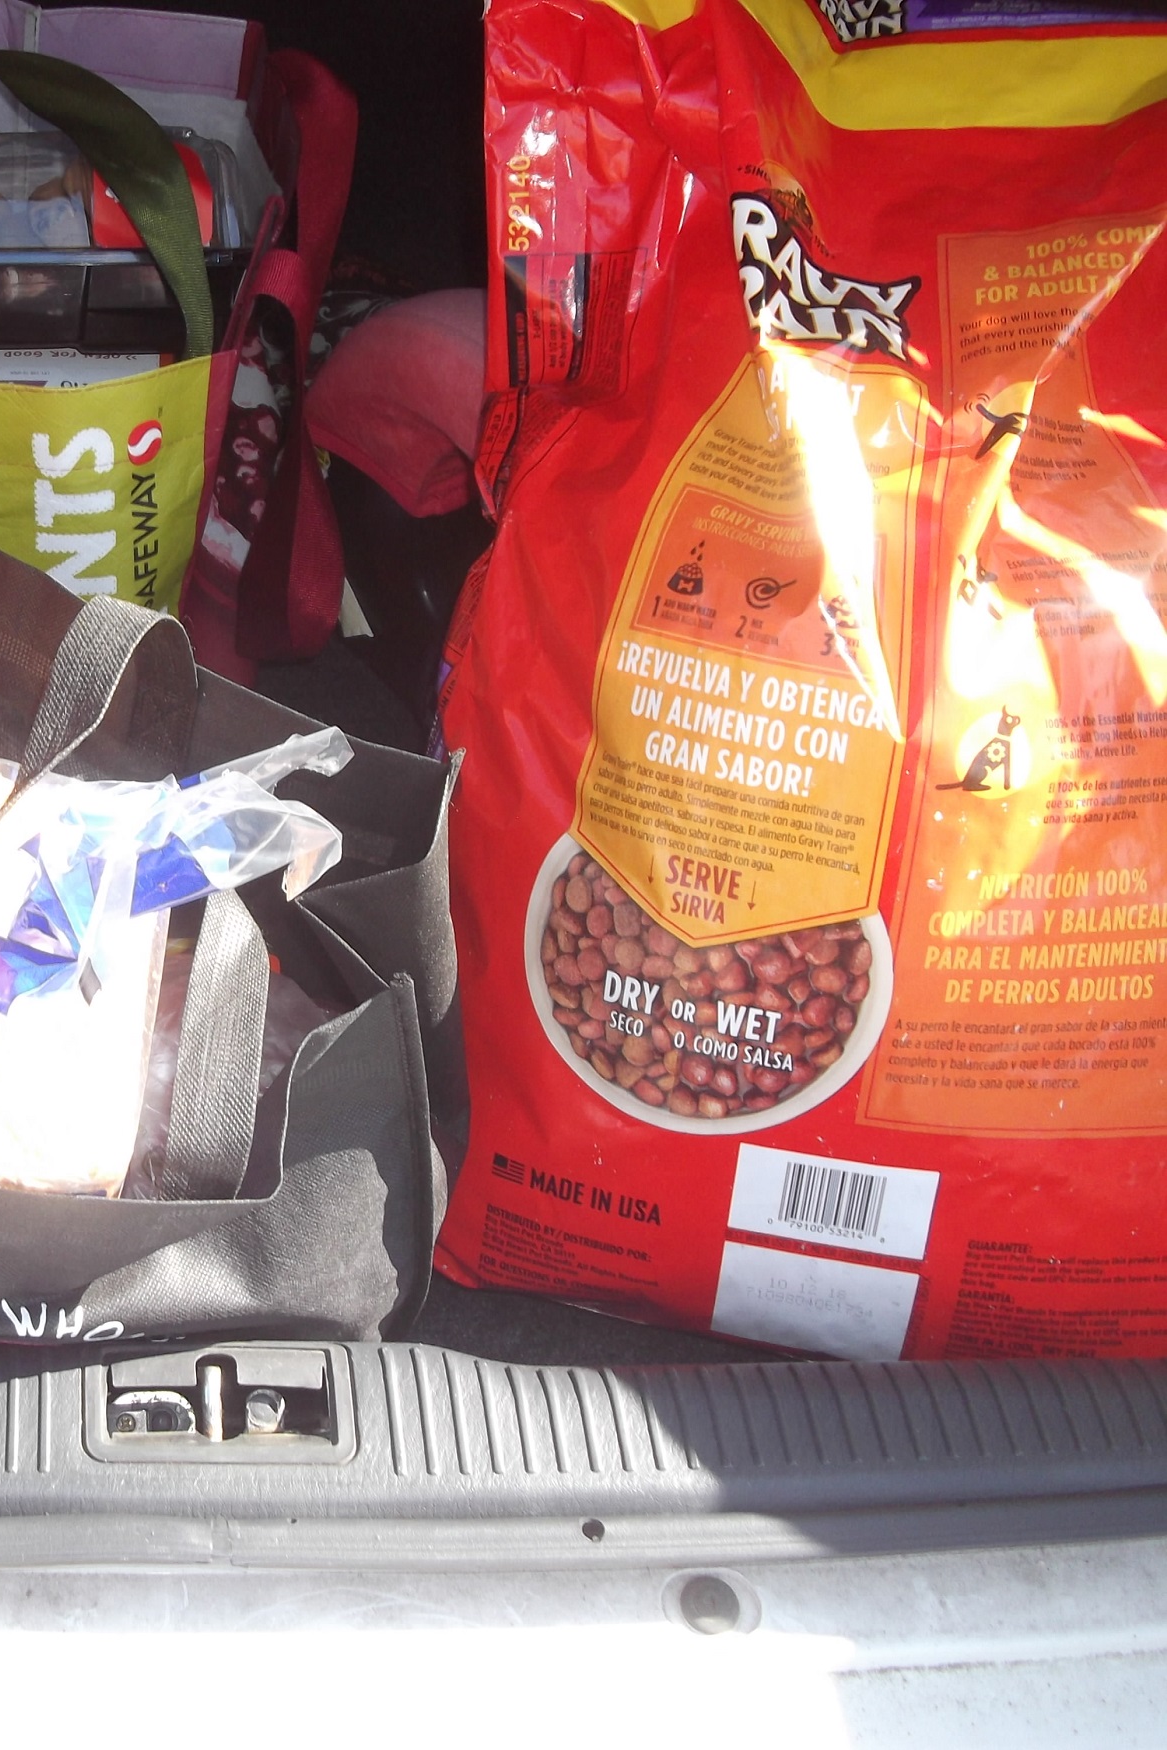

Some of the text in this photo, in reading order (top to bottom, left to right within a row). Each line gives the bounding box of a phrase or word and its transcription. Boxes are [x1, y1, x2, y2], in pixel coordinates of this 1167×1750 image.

[508, 155, 531, 252] 532140
[1026, 233, 1088, 259] 100%
[984, 252, 1125, 281] & BALANCED
[975, 275, 1099, 306] FOR ADULT
[959, 309, 1057, 334] Your dog will love
[960, 328, 1014, 349] that every
[960, 343, 1016, 363] needs and
[714, 429, 737, 444] Gravy
[710, 504, 754, 529] GRAVY
[1012, 572, 1034, 582] Help
[735, 615, 747, 639] 2
[617, 640, 884, 731] ¡REVUELVA Y OBTENGA
[631, 685, 849, 764] UN ALIMENTO CON
[1098, 711, 1135, 725] Essential
[1113, 727, 1137, 740] Needs
[645, 731, 813, 798] GRAN SABOR!
[1094, 745, 1138, 757] Active Life.
[637, 764, 865, 827] hace una comida nutritiva de gran
[1058, 777, 1151, 793] 100% de nutrientes
[1101, 792, 1159, 806] adulto necesita
[677, 809, 824, 850] sabrosa espesa. El alimento Gravy
[686, 793, 856, 841] Simplemente mezcle con agua tibia para
[1043, 810, 1138, 824] una vida sana activa.
[654, 818, 814, 864] delicioso sabor que su perro le
[668, 839, 774, 872] seco mezclado con agua.
[665, 855, 742, 900] SERVE
[979, 866, 1148, 900] NUTRICIÓN 100%
[670, 891, 725, 925] SIRVA
[928, 910, 1035, 937] COMPLETA
[1042, 910, 1056, 934] Y
[924, 946, 983, 970] PARA
[989, 946, 1012, 970] EL
[944, 974, 1155, 1004] DE PERROS ADULTOS
[603, 969, 782, 1044] DRY OR WET
[609, 1011, 793, 1071] SECO O COMO SALSA
[920, 1020, 1137, 1035] perro le gran sabor de la salsa
[924, 1037, 1156, 1051] usted cada bocado 100%
[954, 1078, 1003, 1089] vida sana
[530, 1167, 662, 1226] MADE IN USA
[486, 1203, 541, 1232] DISTRIBUTED
[563, 1232, 625, 1256] DISTRIBUIDO
[789, 1220, 824, 1233] 79100
[829, 1225, 864, 1240] 53214
